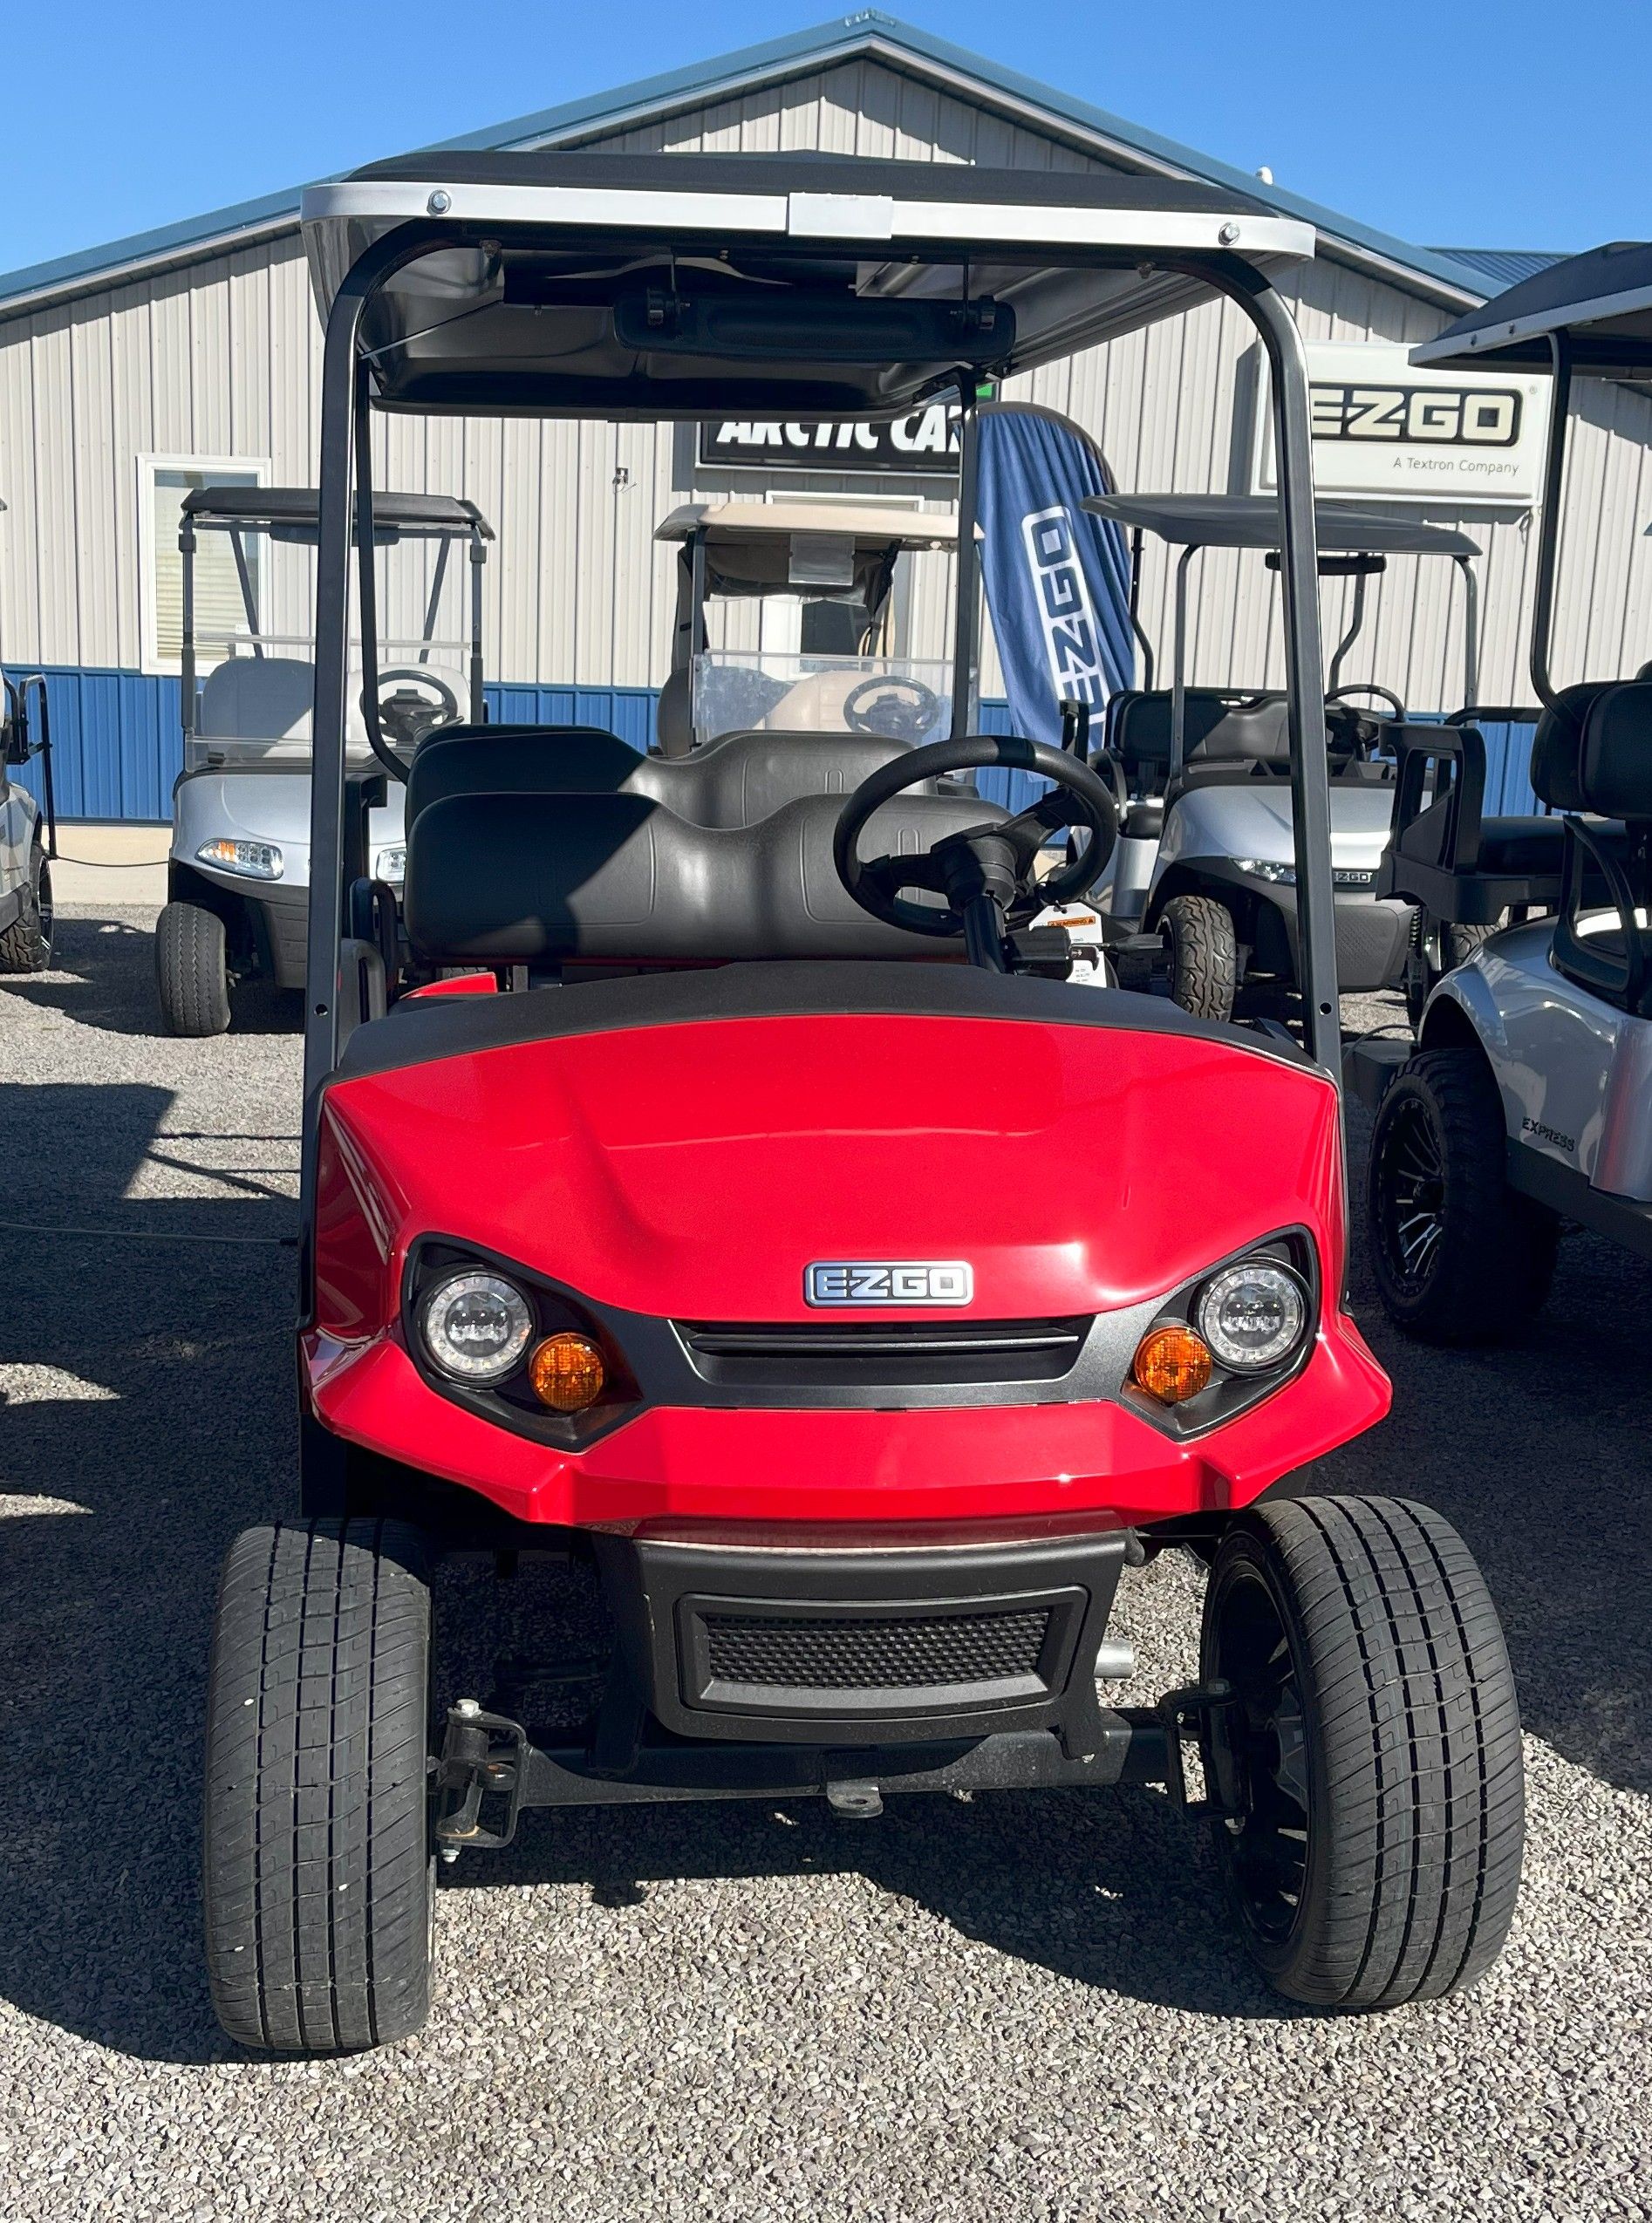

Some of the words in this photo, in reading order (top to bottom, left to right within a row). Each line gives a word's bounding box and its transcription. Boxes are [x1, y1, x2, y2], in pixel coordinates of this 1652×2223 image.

[1310, 389, 1515, 441] EZGO
[1393, 457, 1402, 468] A
[1407, 457, 1454, 471] Textron
[1458, 459, 1519, 477] Company
[1521, 1116, 1575, 1152] EXPRESS
[816, 1268, 965, 1299] EZGO
